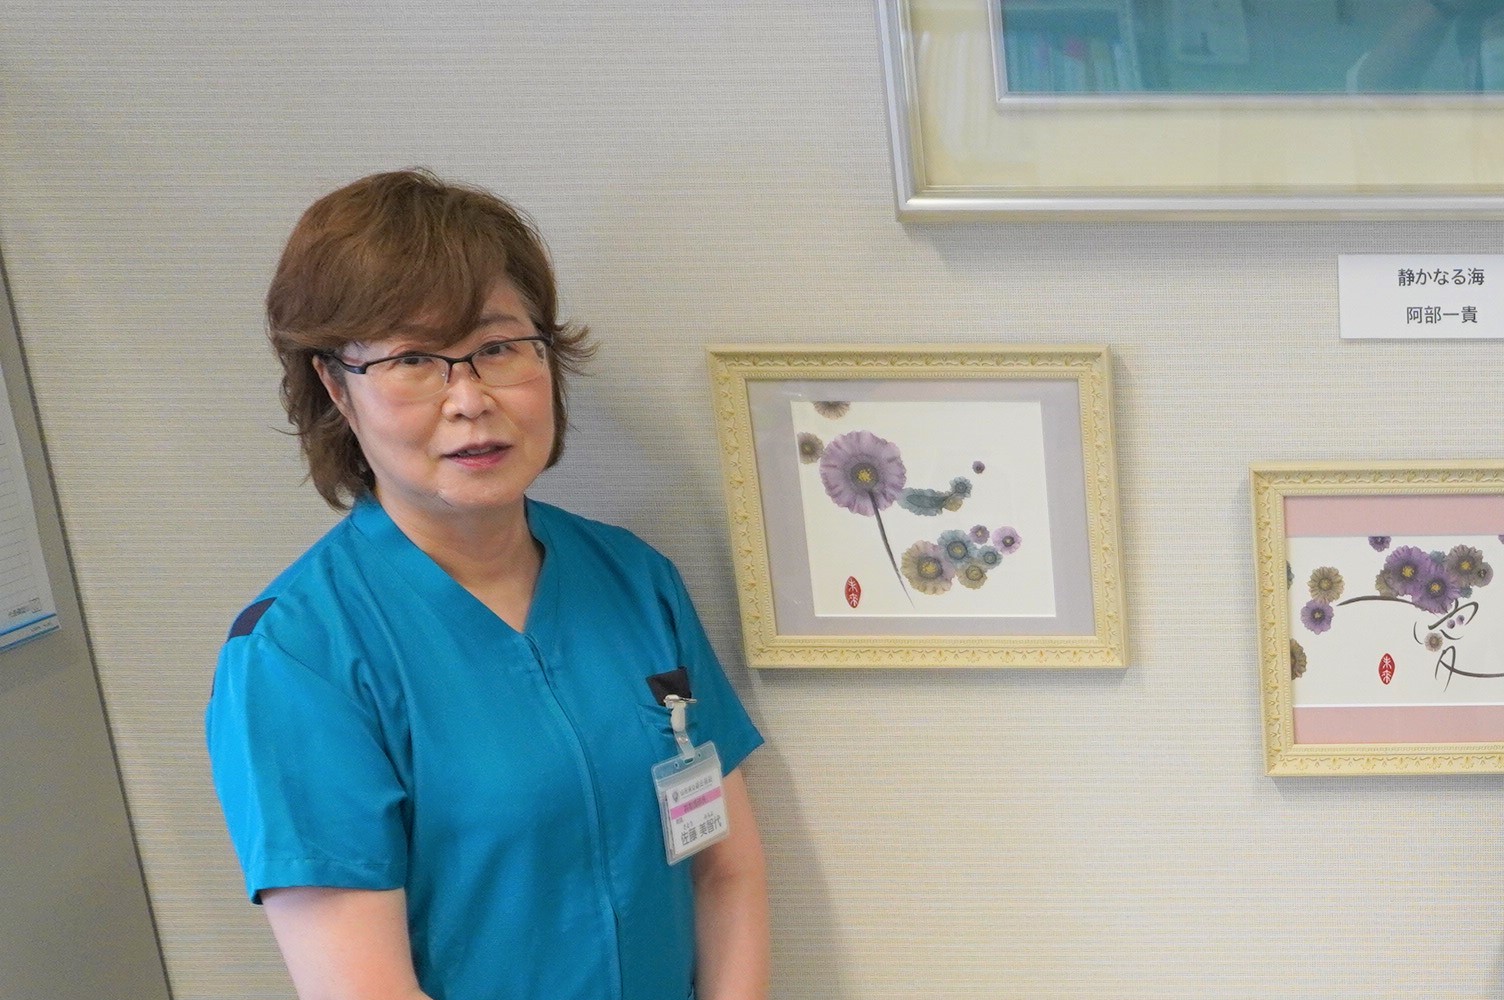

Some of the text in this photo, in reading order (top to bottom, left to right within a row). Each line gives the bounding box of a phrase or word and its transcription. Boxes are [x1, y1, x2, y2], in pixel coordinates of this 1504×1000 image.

[1397, 267, 1486, 287] 静かなる海
[1405, 305, 1479, 325] 阿部一貴
